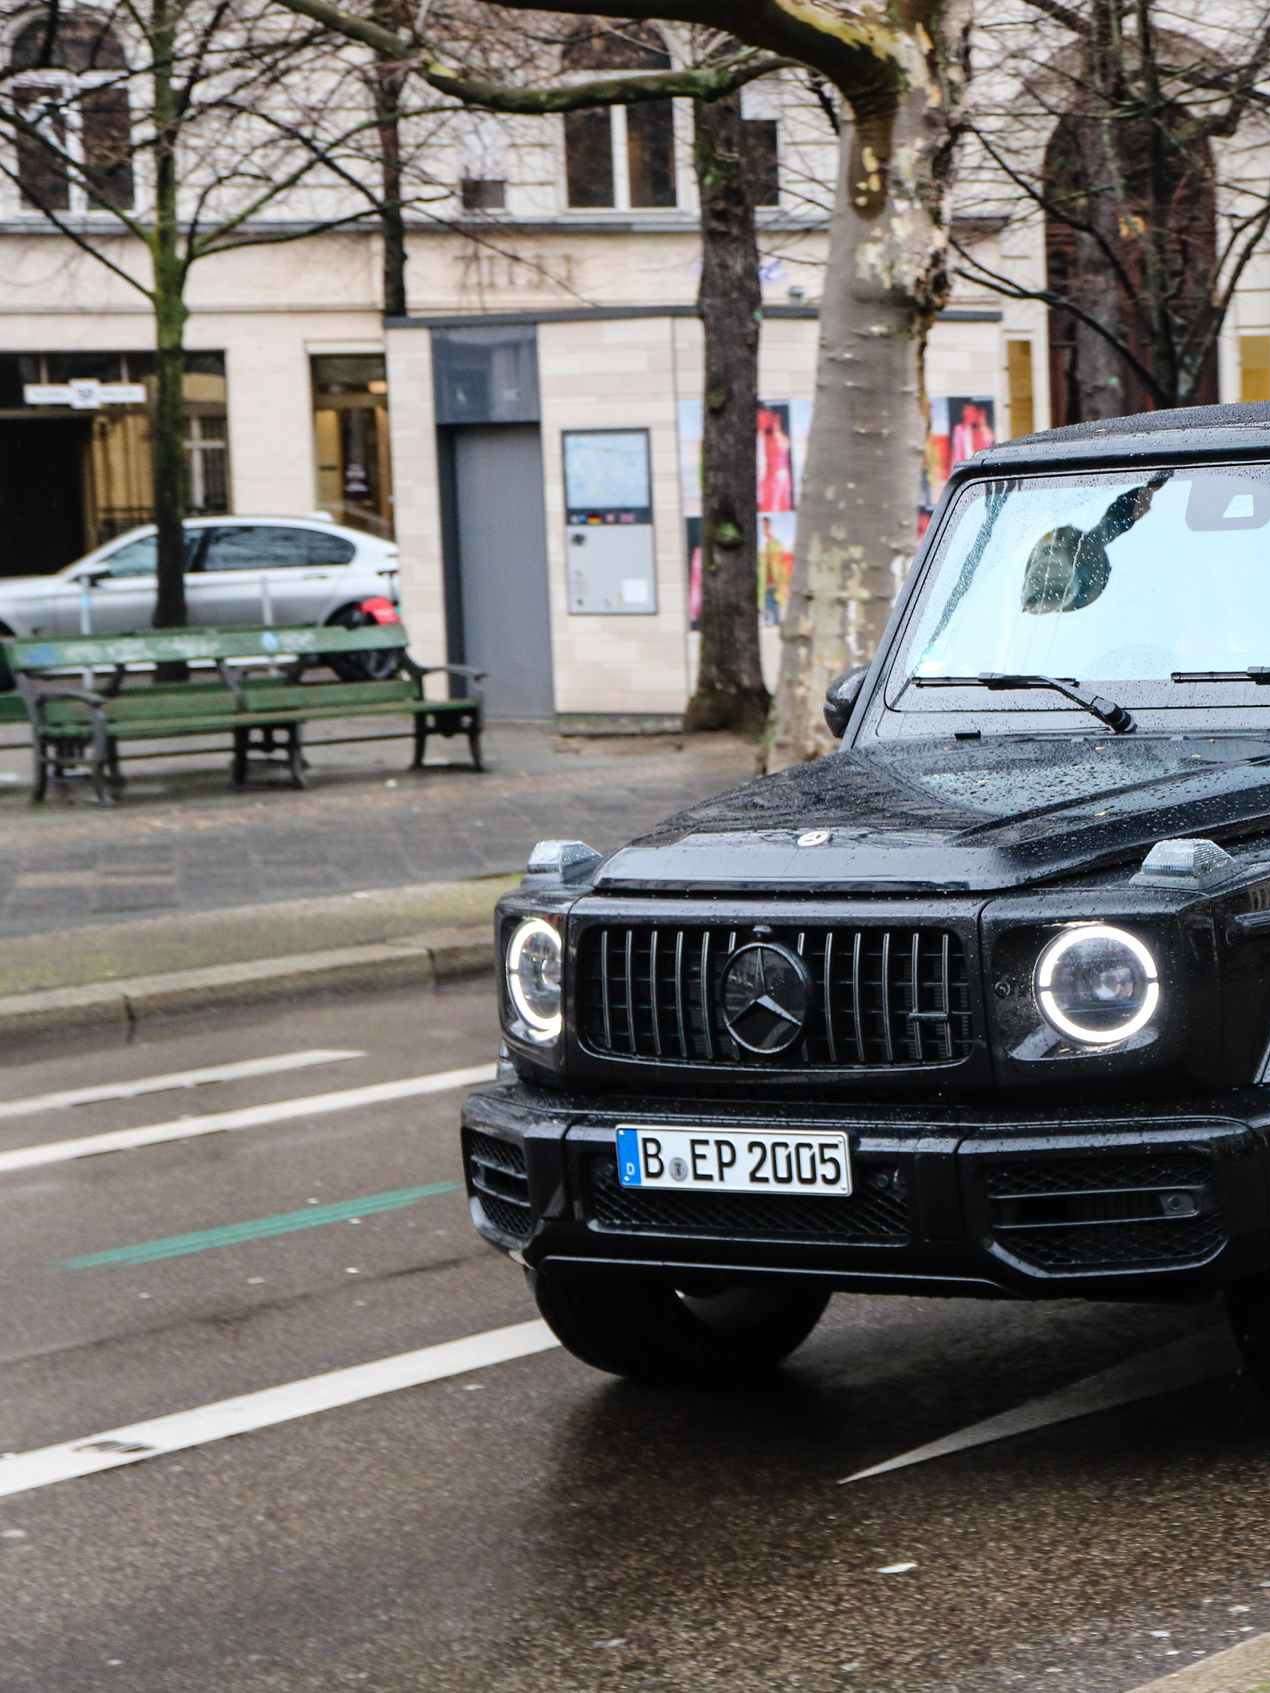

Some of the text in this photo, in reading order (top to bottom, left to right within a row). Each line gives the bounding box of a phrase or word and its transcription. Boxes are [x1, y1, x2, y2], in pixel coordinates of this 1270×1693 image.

[625, 1162, 636, 1175] D
[641, 1136, 842, 1186] B EP 2005
